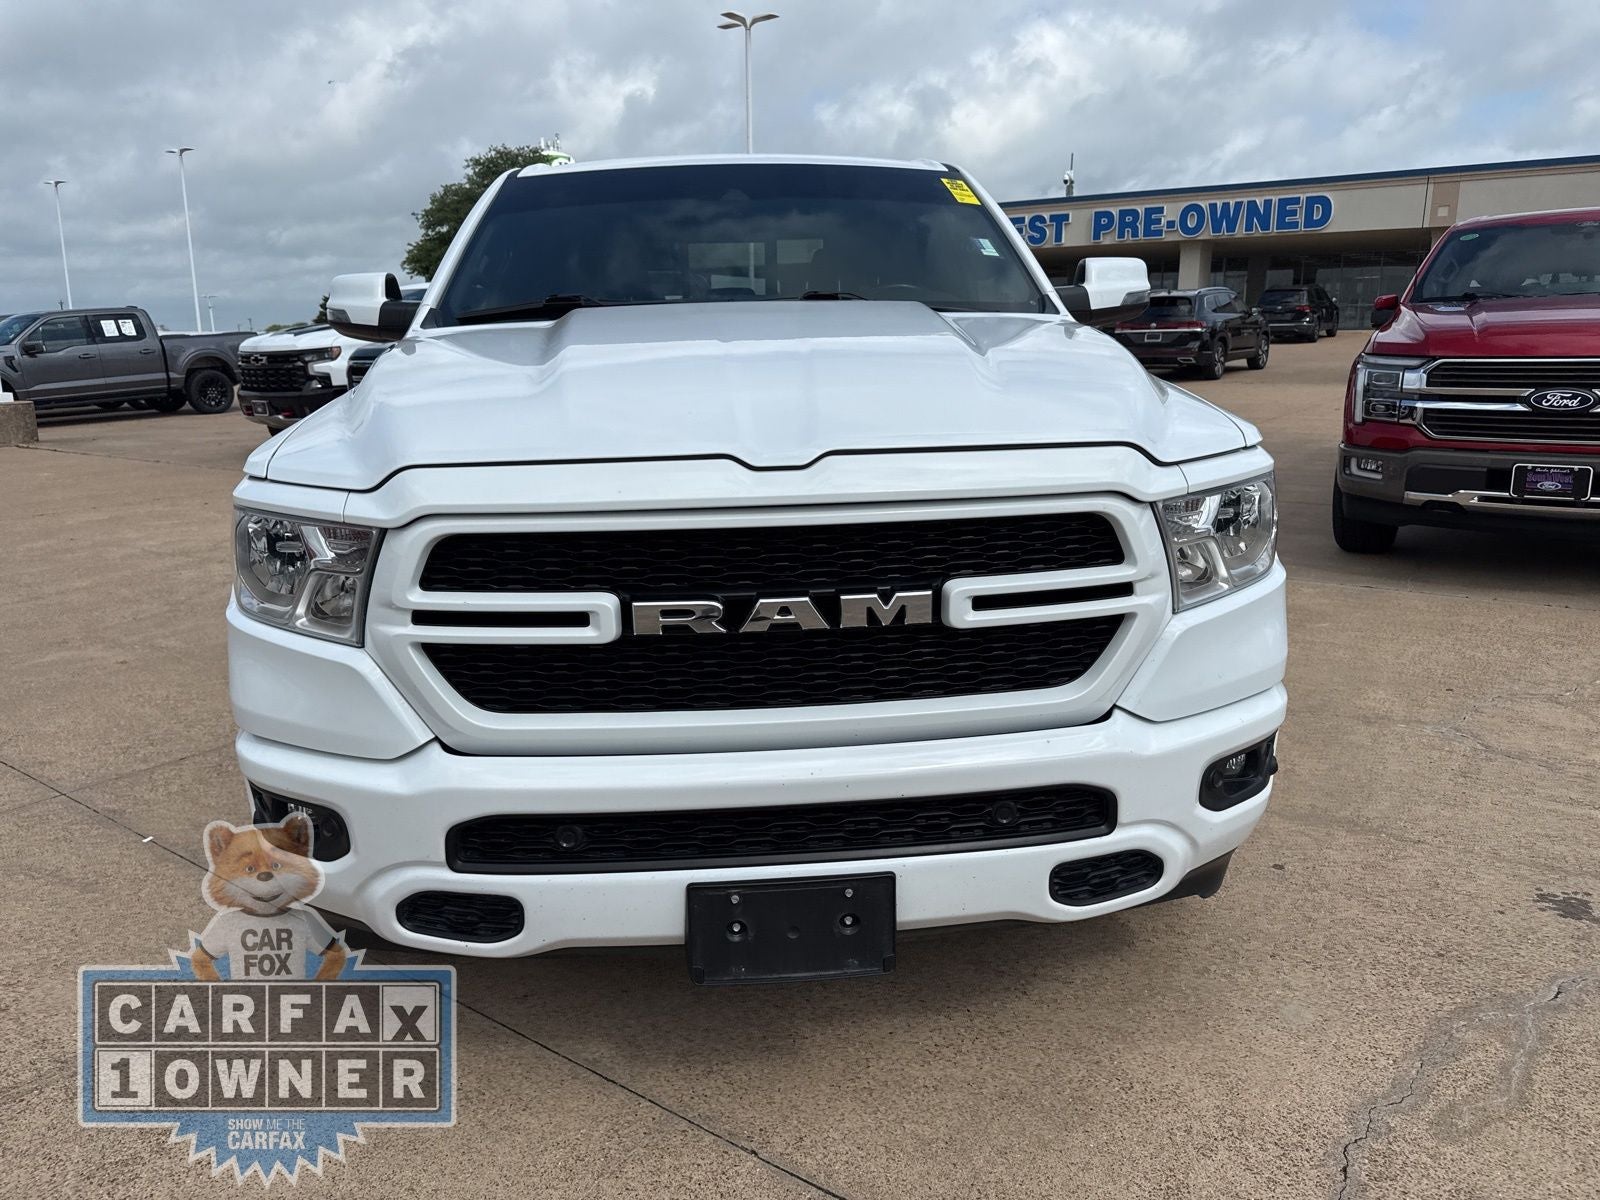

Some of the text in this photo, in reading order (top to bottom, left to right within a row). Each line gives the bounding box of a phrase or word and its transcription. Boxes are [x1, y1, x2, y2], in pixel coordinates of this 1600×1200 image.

[1092, 194, 1334, 242] PRE-OWNED
[1542, 392, 1581, 406] Ford
[632, 591, 933, 635] RAM
